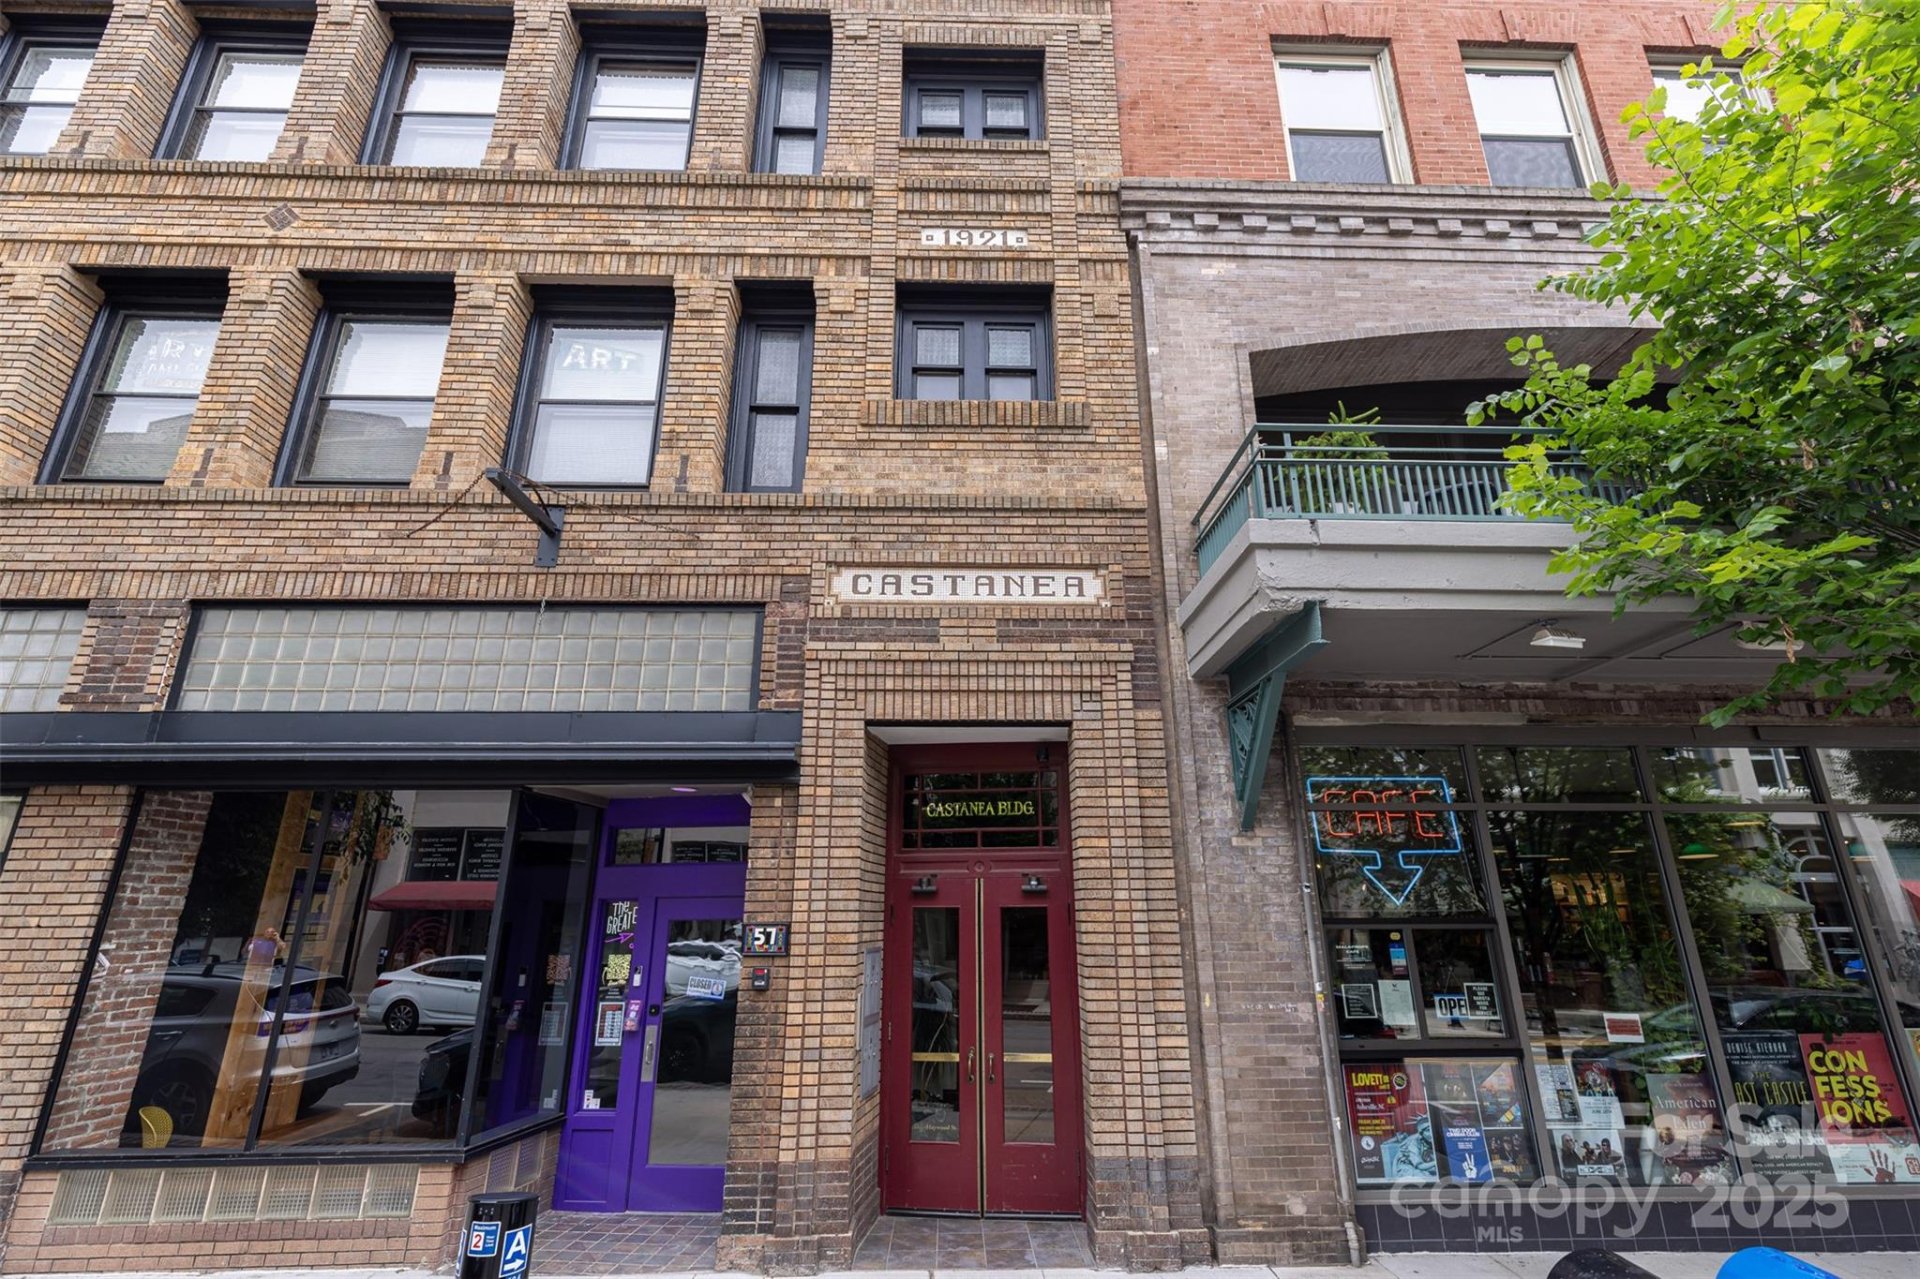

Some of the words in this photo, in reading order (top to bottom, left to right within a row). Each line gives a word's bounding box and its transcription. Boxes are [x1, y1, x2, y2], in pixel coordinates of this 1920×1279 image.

[944, 230, 1008, 246] 1921
[852, 574, 1086, 597] CASTANEA
[926, 802, 995, 817] CASTANEA
[1324, 790, 1443, 837] CAFE
[754, 928, 776, 945] 57
[1439, 998, 1466, 1016] OPE
[1809, 1050, 1868, 1073] CON
[1734, 1082, 1758, 1104] AST
[1815, 1075, 1881, 1098] FESS
[1655, 1095, 1717, 1108] American
[1822, 1100, 1893, 1124] IONS
[473, 1234, 482, 1248] 2
[505, 1230, 526, 1260] A
